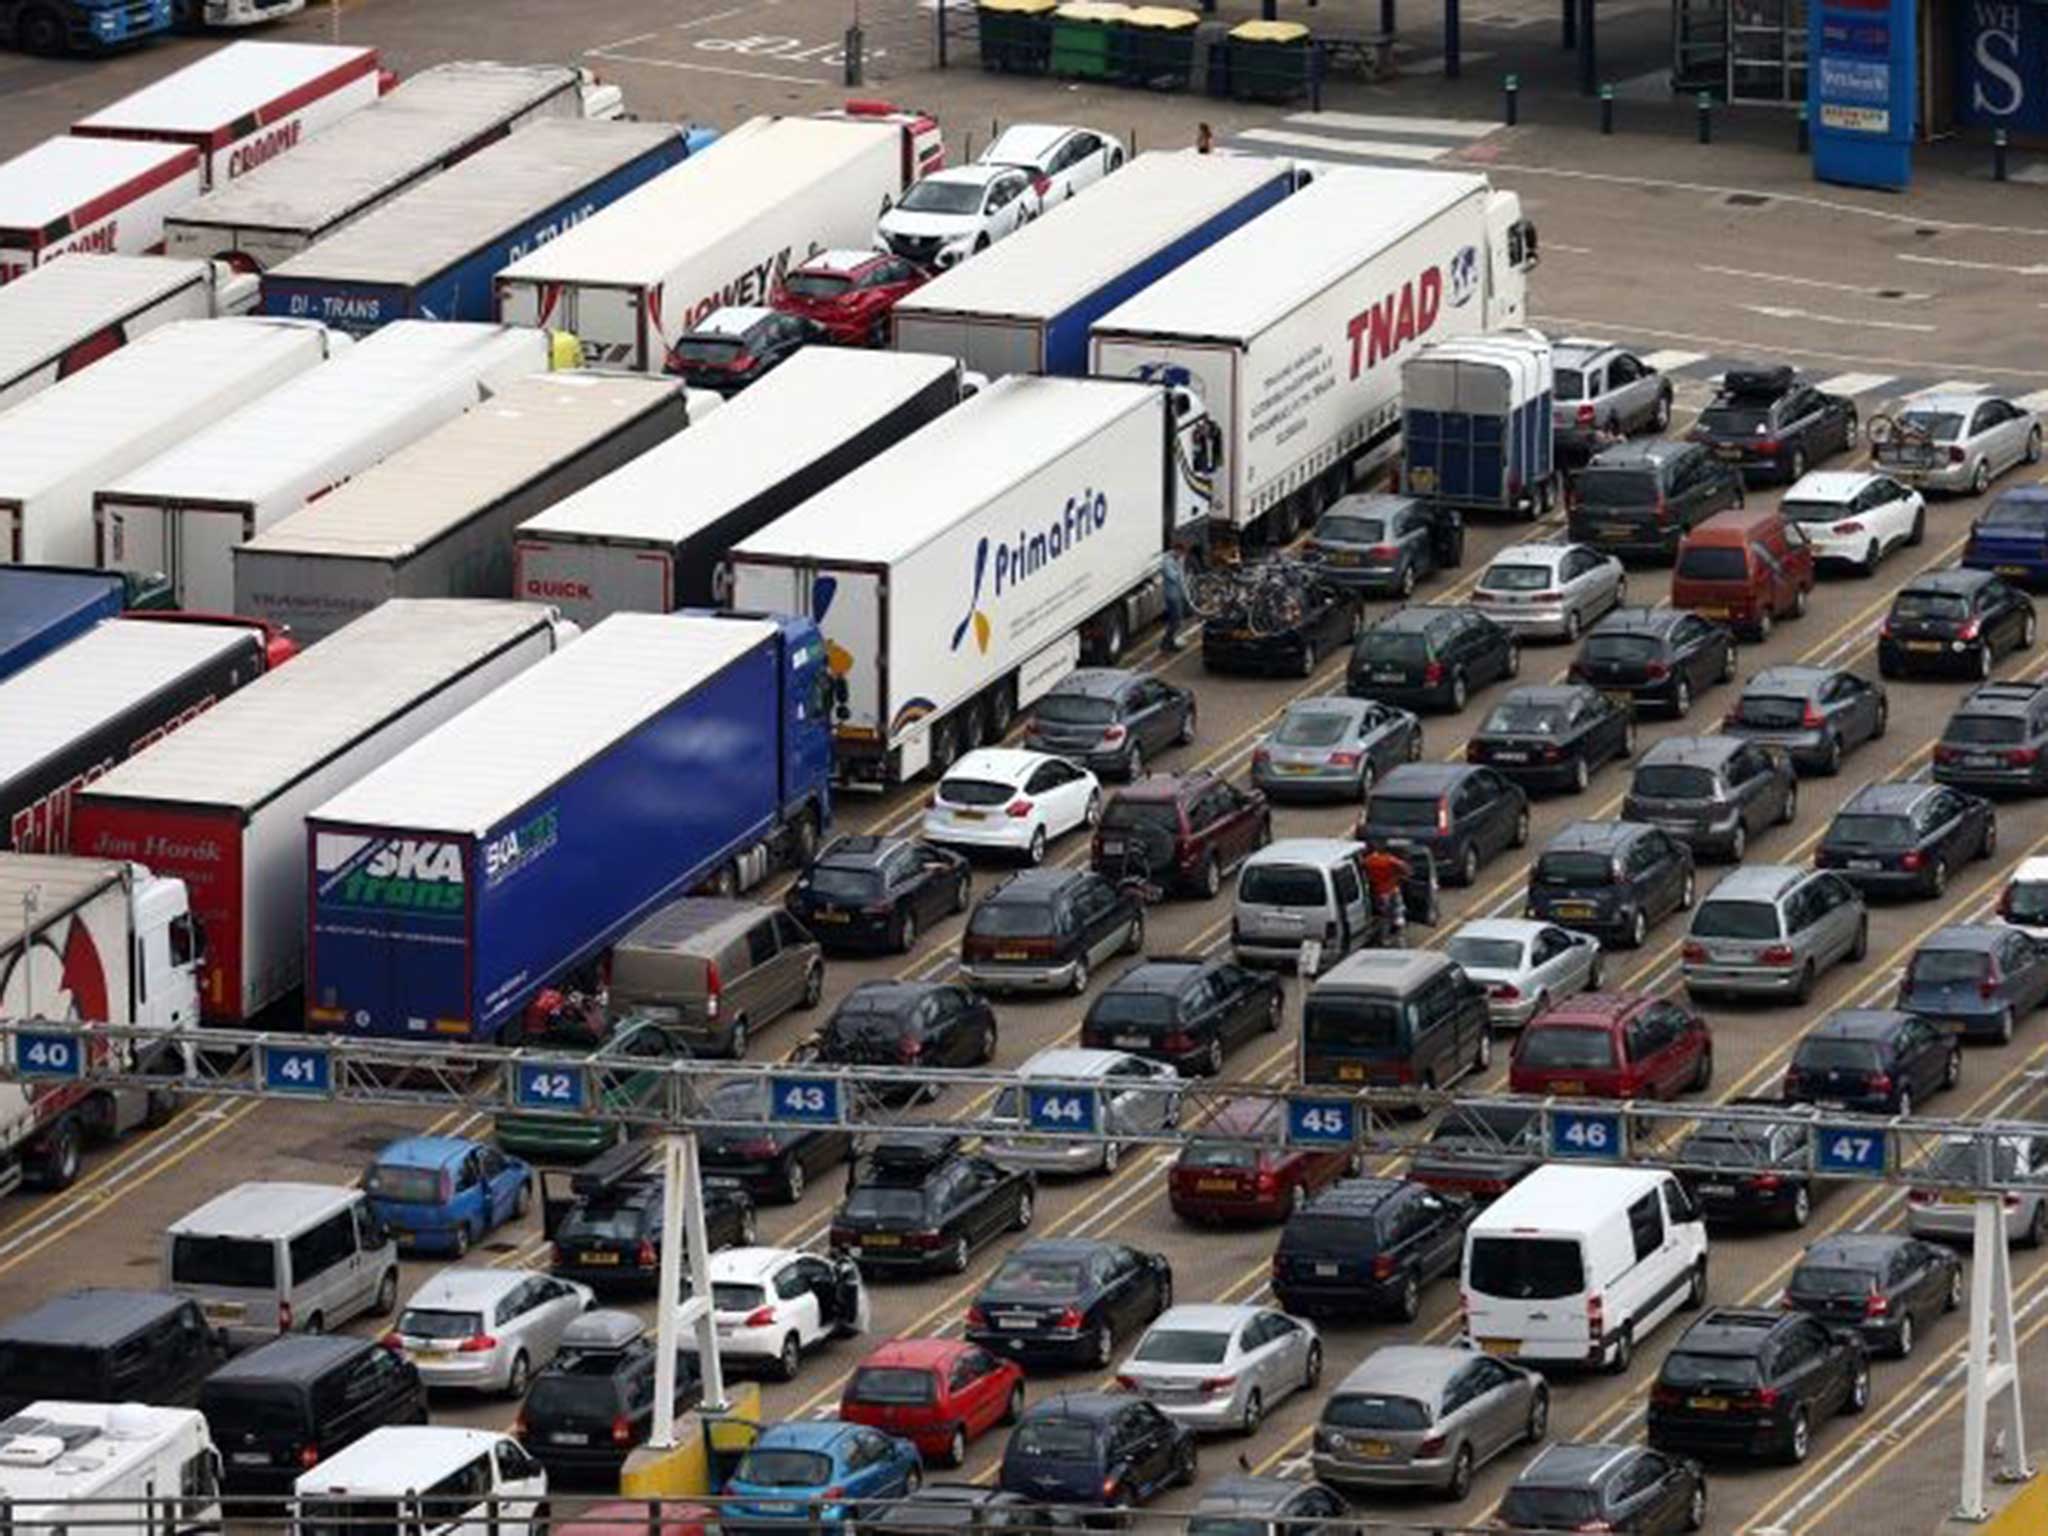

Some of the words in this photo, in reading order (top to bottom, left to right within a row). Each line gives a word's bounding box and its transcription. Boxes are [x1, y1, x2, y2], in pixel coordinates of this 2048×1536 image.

[322, 296, 379, 320] TRANS
[1347, 265, 1441, 382] TNAD
[527, 579, 593, 600] QUICK
[366, 839, 464, 883] SKA
[28, 1043, 68, 1067] 40
[281, 1055, 316, 1081] 41
[531, 1074, 571, 1098] 42
[785, 1087, 826, 1111] 43
[1042, 1099, 1083, 1122] 44
[1302, 1108, 1343, 1133] 45
[1565, 1122, 1607, 1147] 46
[1832, 1137, 1873, 1162] 47
